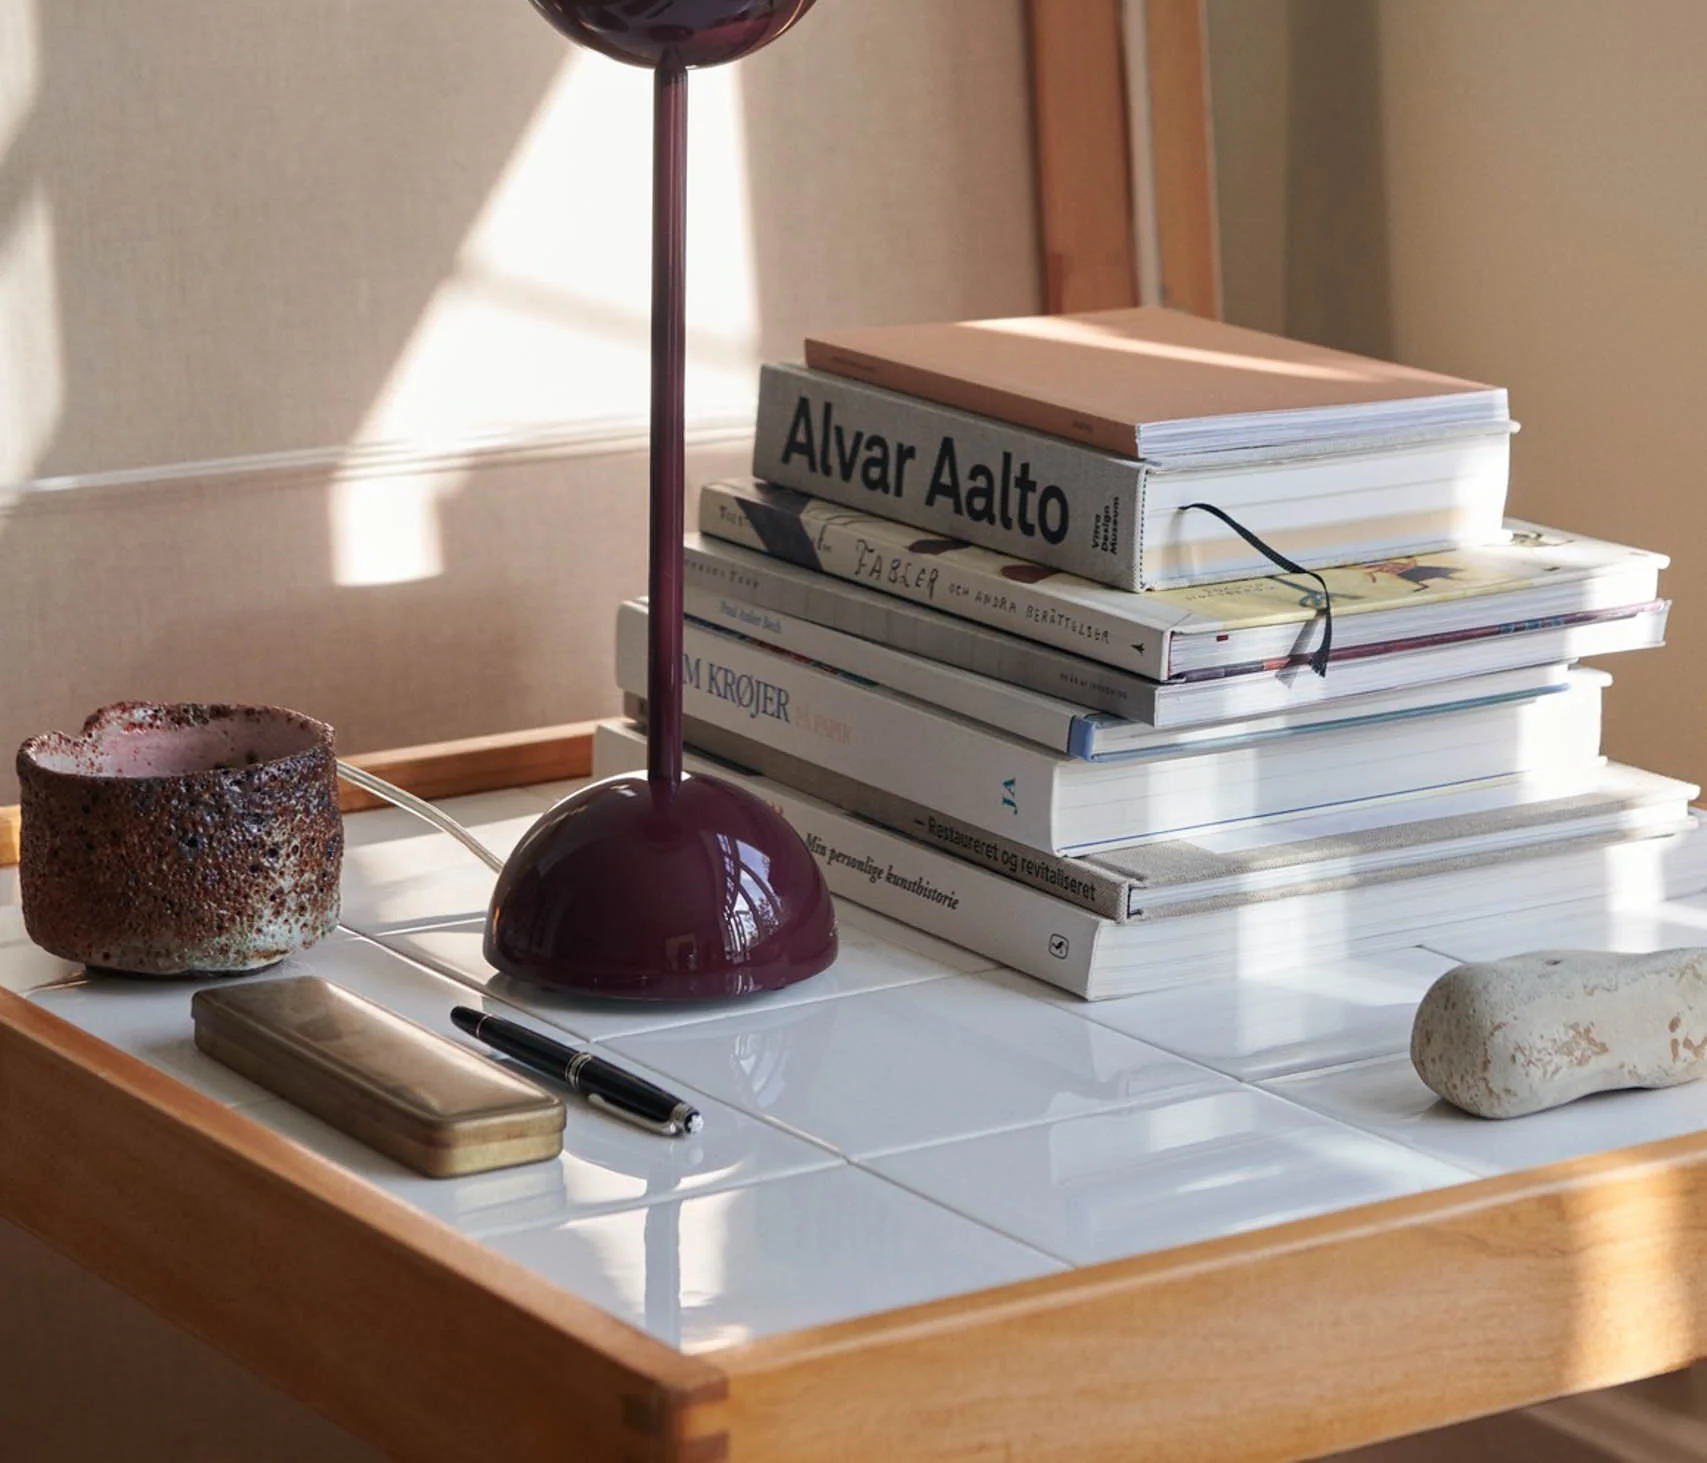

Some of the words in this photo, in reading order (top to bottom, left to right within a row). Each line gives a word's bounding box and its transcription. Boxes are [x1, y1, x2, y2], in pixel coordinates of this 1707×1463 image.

[782, 396, 916, 498] Alvar
[925, 435, 1070, 545] Aalto
[1092, 514, 1101, 548] Vitra
[1101, 505, 1111, 552] Design
[1110, 496, 1119, 555] Museum
[854, 538, 940, 601] FABLER
[707, 662, 790, 724] KRØJER
[805, 833, 826, 857] Min
[827, 848, 884, 884] personlige
[884, 864, 960, 910] kunsthistorie
[927, 816, 999, 862] Restaureret
[1001, 849, 1019, 873] og
[1020, 856, 1096, 902] revitaliseret
